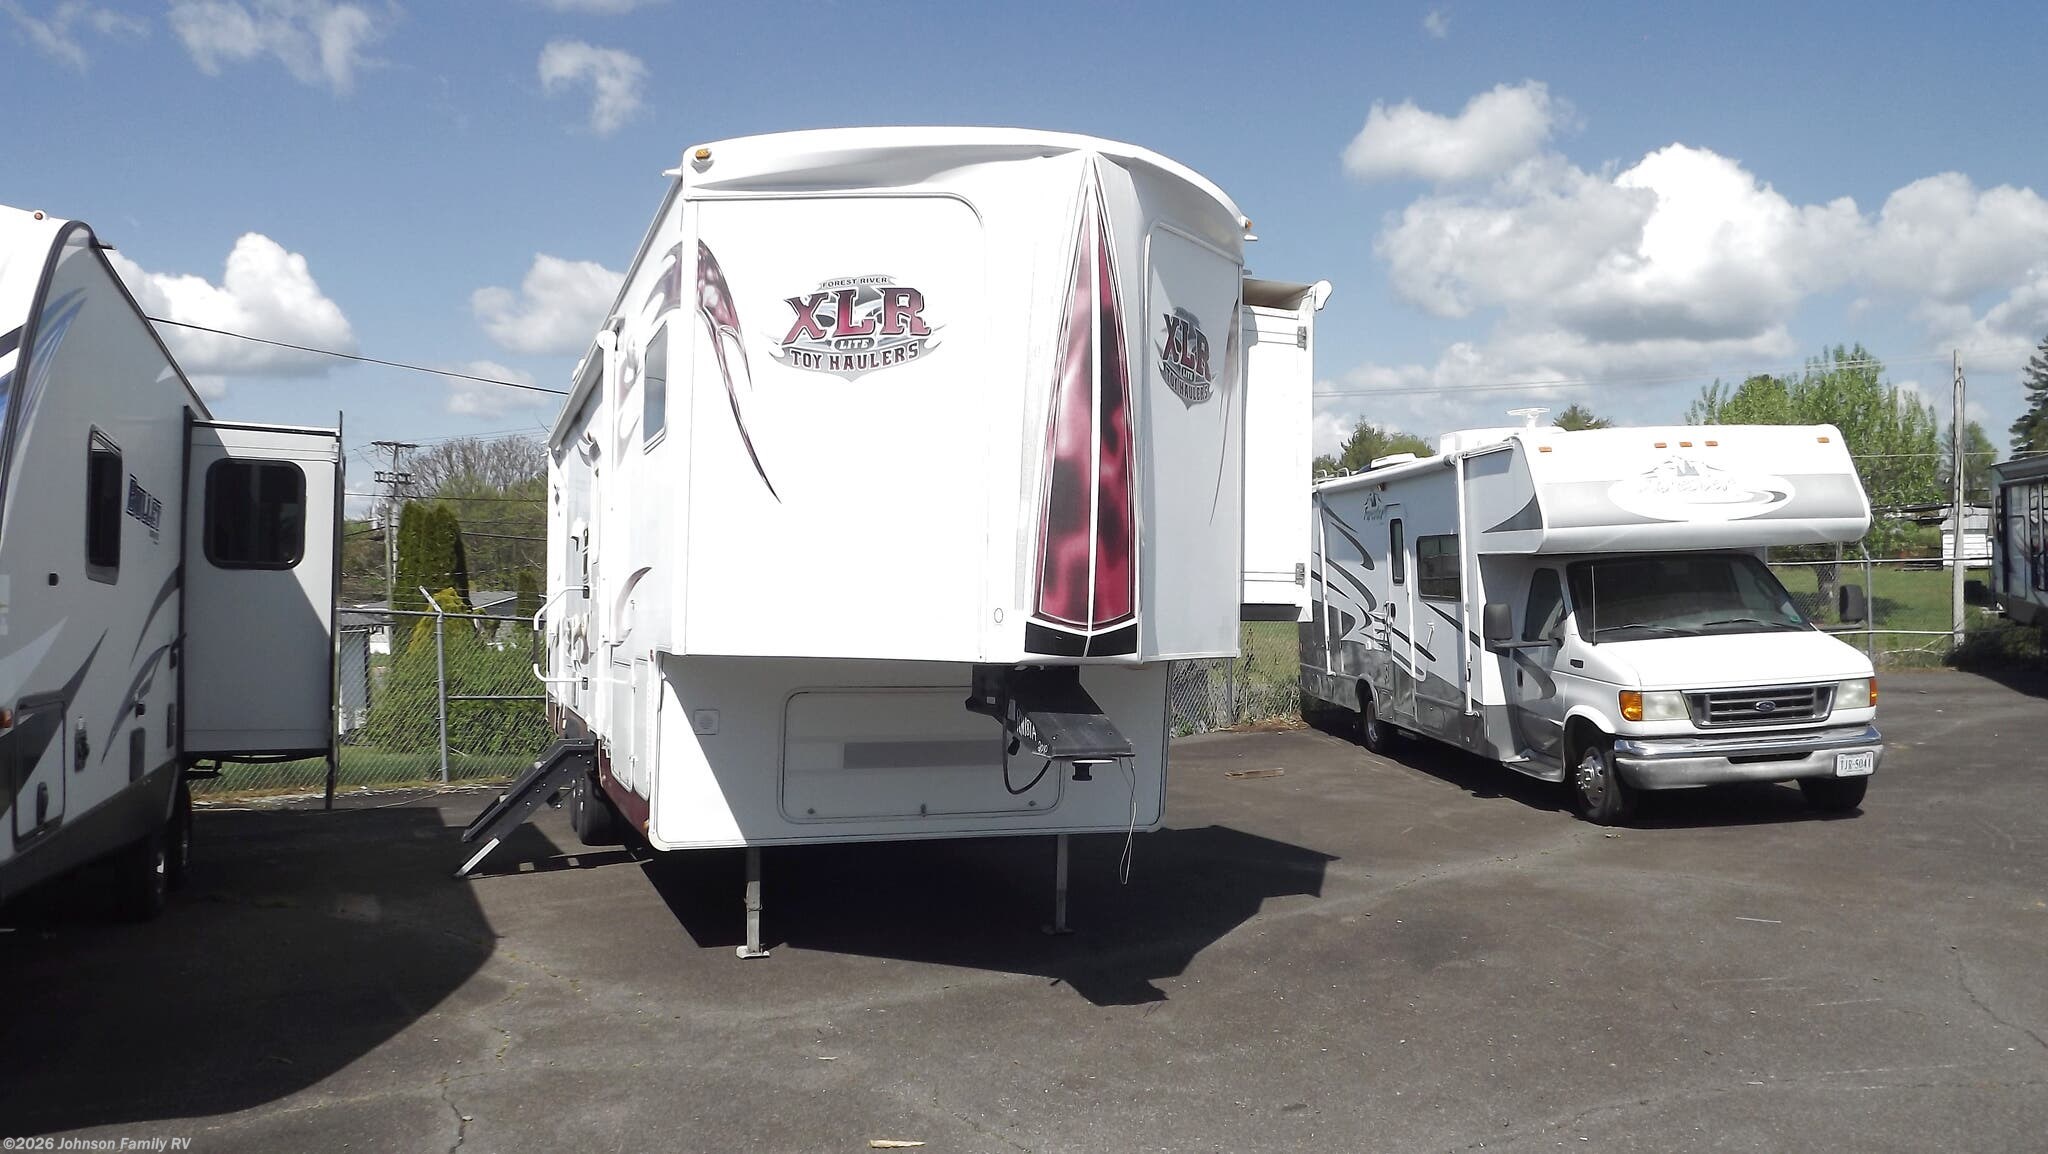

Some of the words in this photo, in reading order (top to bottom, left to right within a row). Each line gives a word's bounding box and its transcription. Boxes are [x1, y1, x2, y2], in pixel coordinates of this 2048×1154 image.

[822, 278, 857, 288] FOREST
[860, 276, 889, 285] RIVER
[782, 287, 932, 346] XLR
[790, 350, 823, 370] TOY
[829, 342, 920, 371] HAULERS
[838, 339, 870, 350] LITE
[1162, 313, 1212, 384] XLR
[1179, 380, 1209, 401] HAULERS
